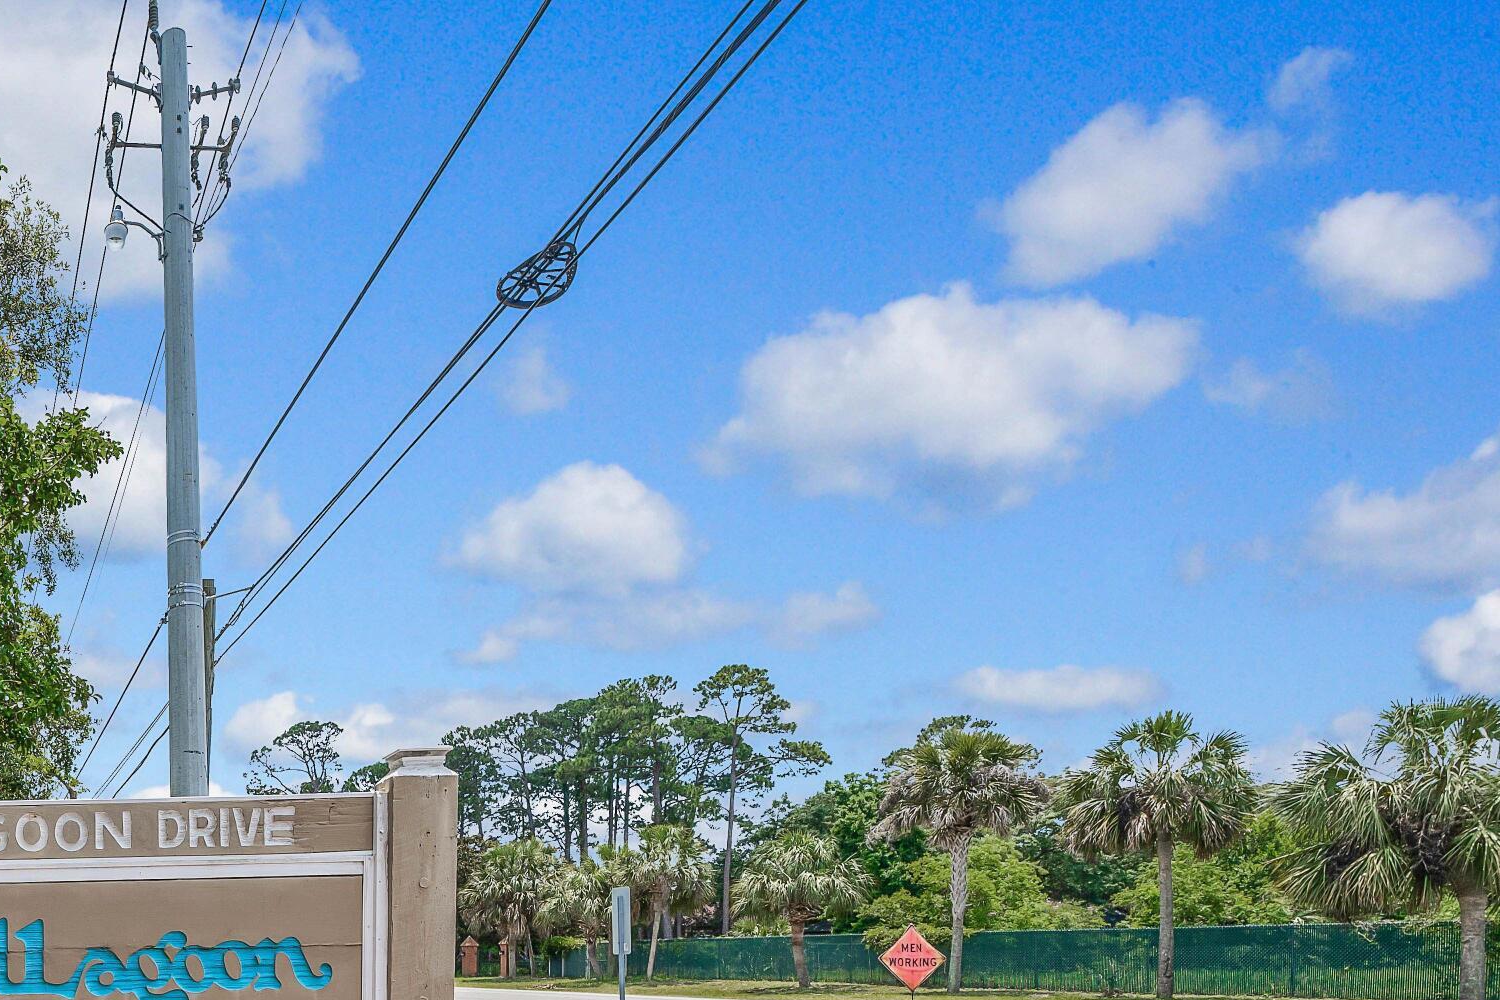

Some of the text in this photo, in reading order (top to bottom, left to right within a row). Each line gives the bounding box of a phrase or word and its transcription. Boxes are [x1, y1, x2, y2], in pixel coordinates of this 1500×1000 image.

[157, 805, 297, 849] DRIVE
[901, 943, 922, 952] MEN
[889, 957, 937, 967] WORKING
